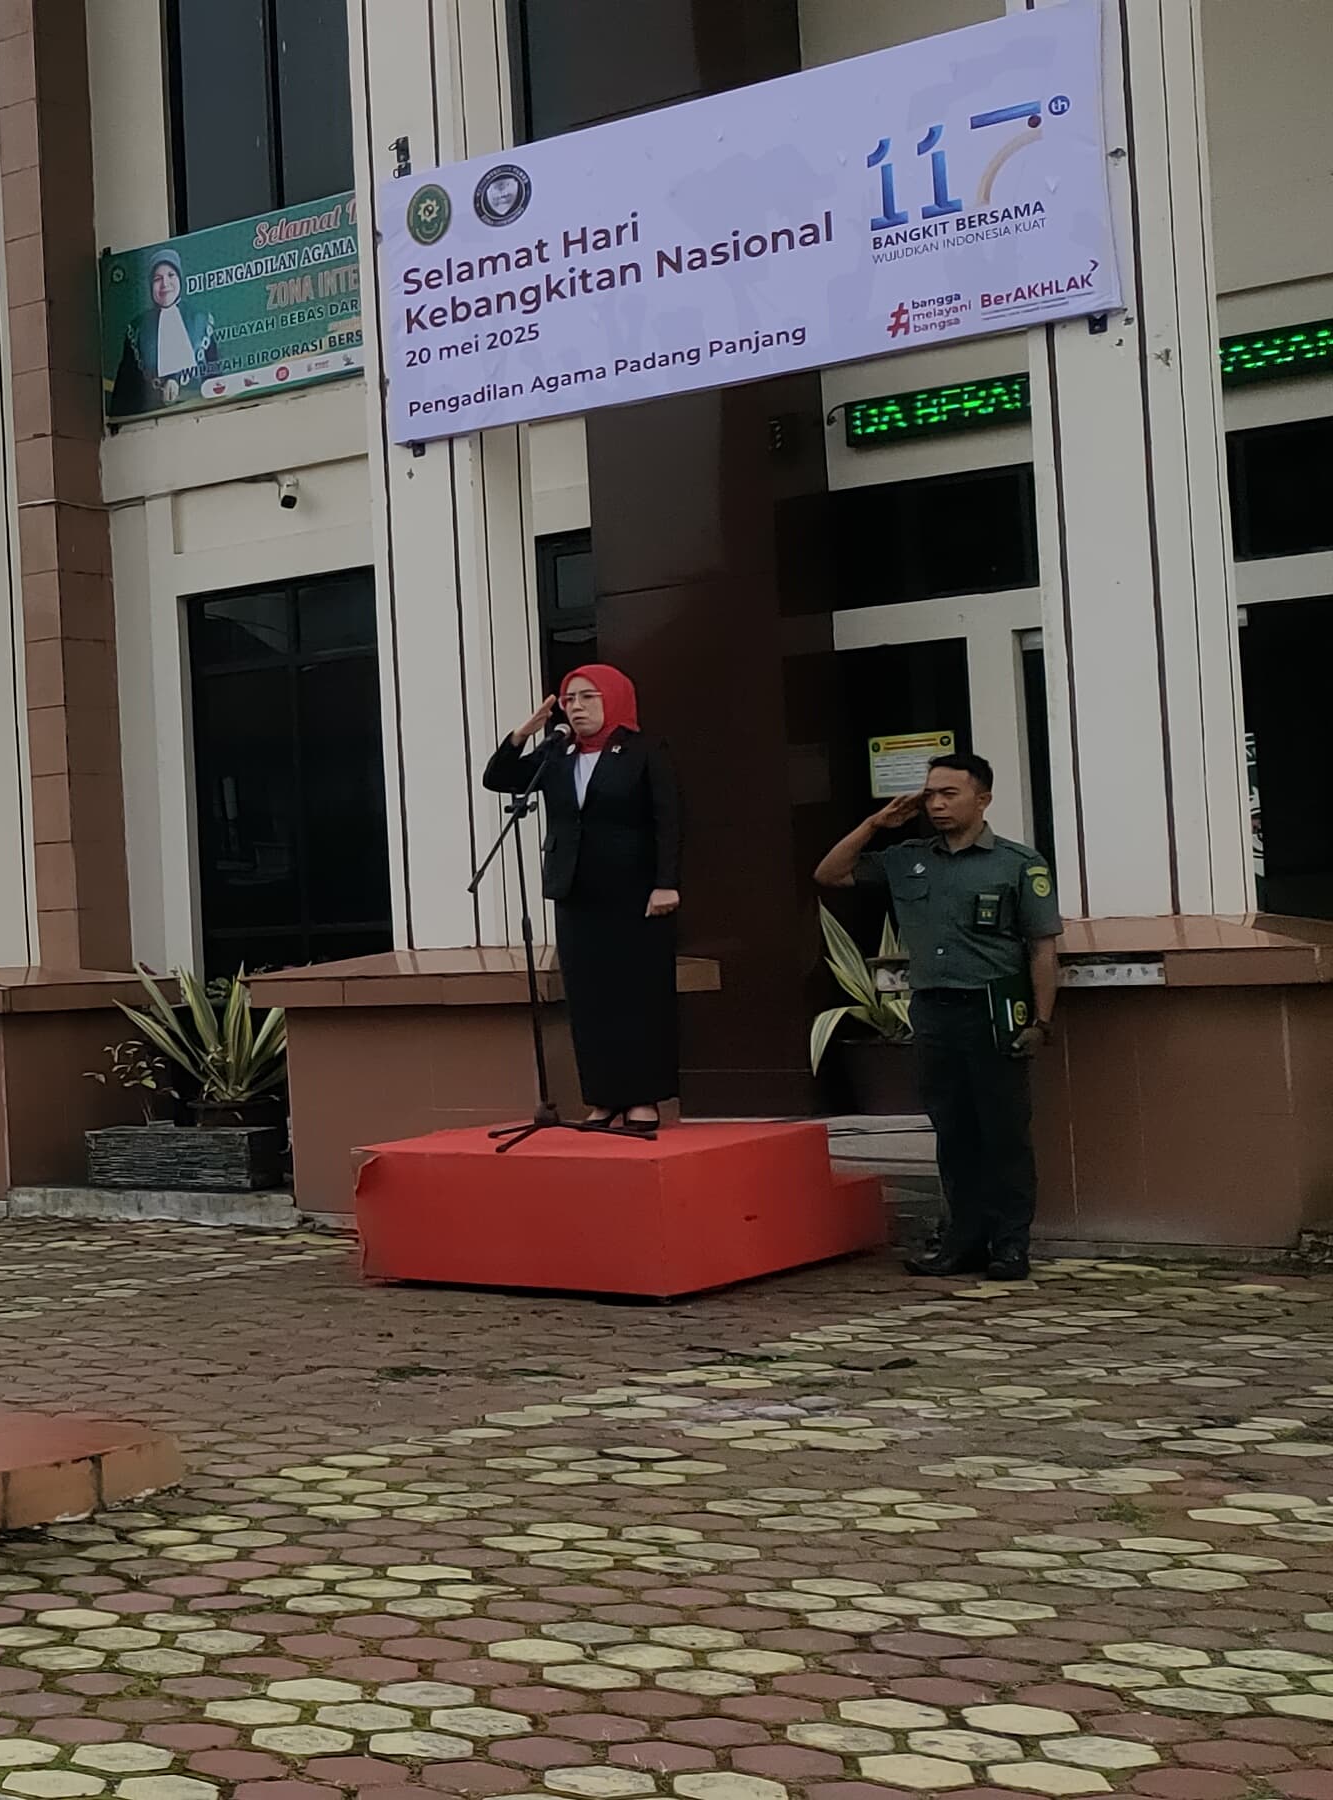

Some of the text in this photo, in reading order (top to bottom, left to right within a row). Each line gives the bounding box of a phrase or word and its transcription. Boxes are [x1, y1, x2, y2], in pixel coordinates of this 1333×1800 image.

[253, 203, 342, 249] Selamat
[872, 200, 1046, 250] BANGKIT BERSAMA
[872, 217, 1047, 265] WUJUDKAN INDONESIA KUAT
[187, 236, 357, 294] DI PENGADILAN AGAMA
[403, 211, 639, 295] Selamat Hari
[405, 211, 833, 335] Kebangkitan Nasional
[266, 275, 315, 311] ZONA
[911, 293, 962, 310] bangga
[912, 300, 972, 321] melayani
[980, 273, 1094, 309] BerAKHLAK
[213, 318, 276, 343] WILAYAH
[281, 306, 325, 327] BEBAS
[405, 323, 540, 368] 20 mei 2025
[913, 316, 961, 334] bangsa
[247, 337, 324, 366] BIROKRASI
[409, 327, 807, 417] Pengadilan Agama Padang Panjang
